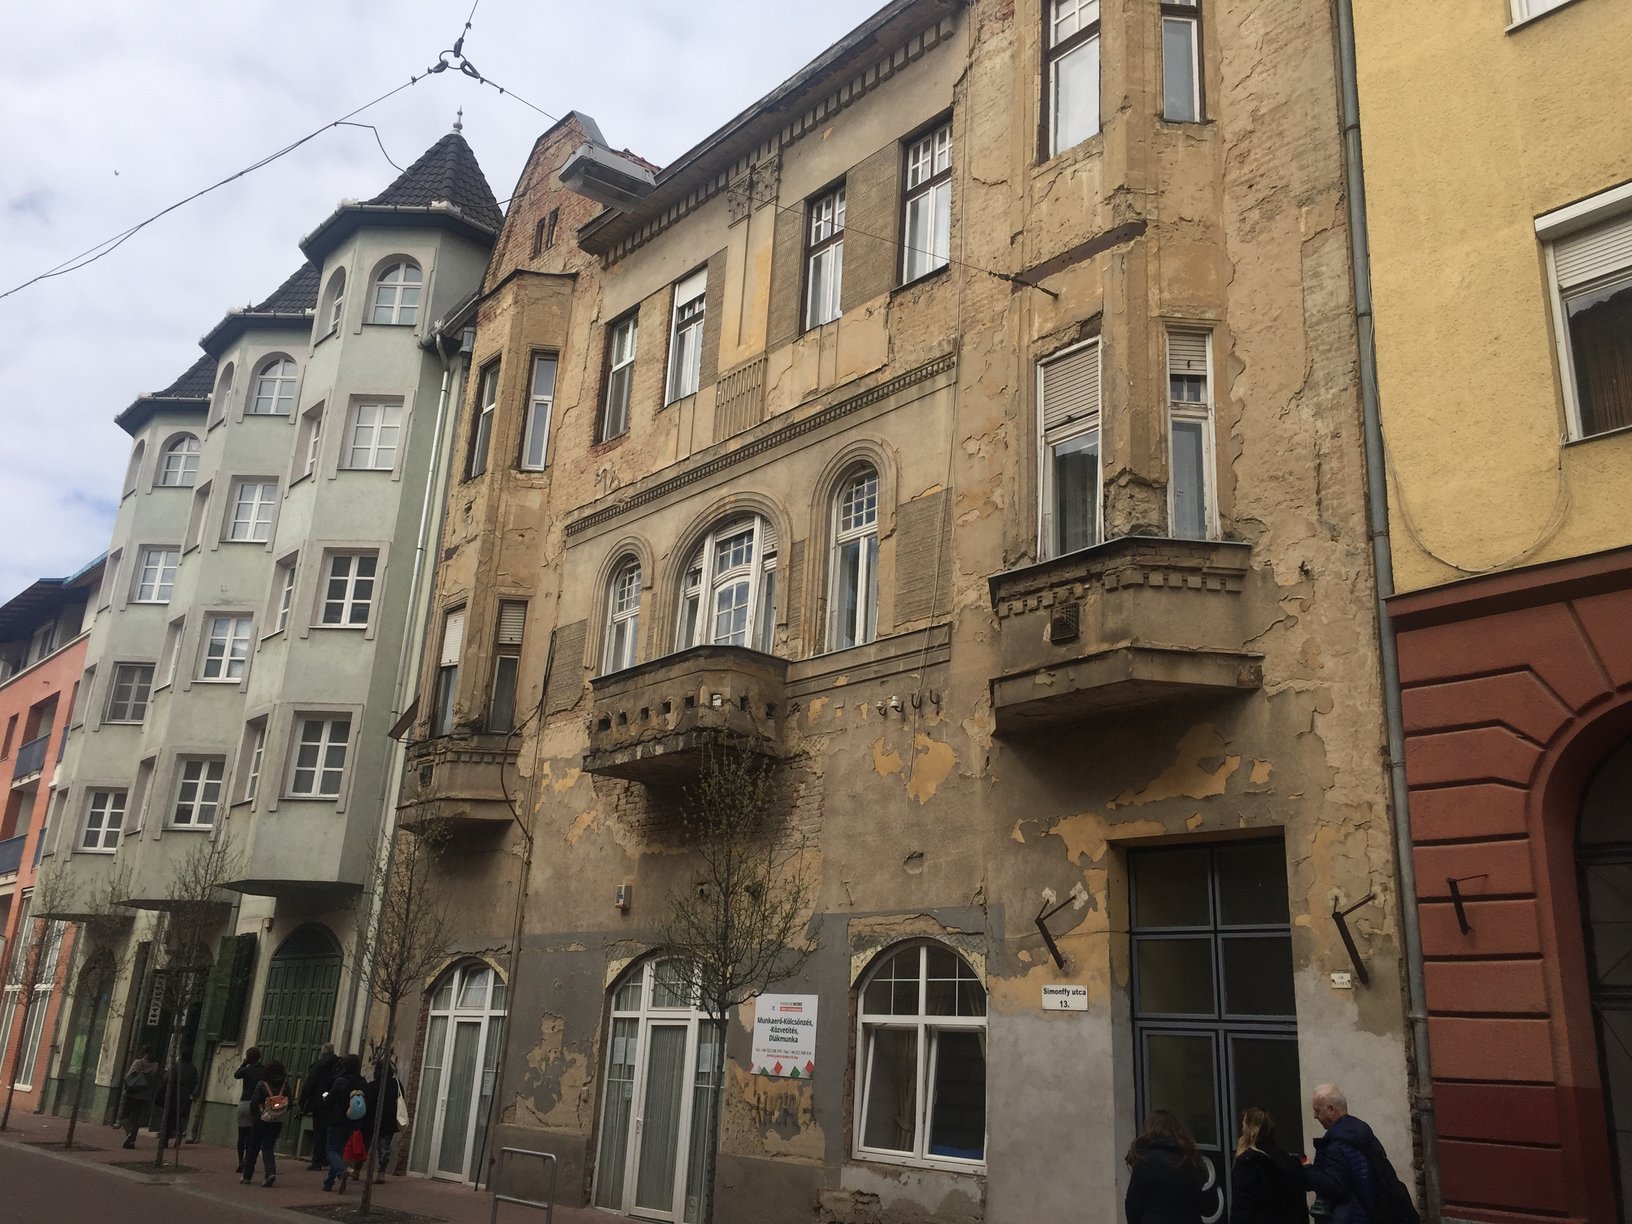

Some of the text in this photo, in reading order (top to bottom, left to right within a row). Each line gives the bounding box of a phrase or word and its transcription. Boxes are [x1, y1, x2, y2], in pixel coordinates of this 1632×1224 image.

[1043, 988, 1070, 996] Simonffy
[1060, 1000, 1070, 1008] 13.
[769, 1034, 798, 1043] Diákmunka
